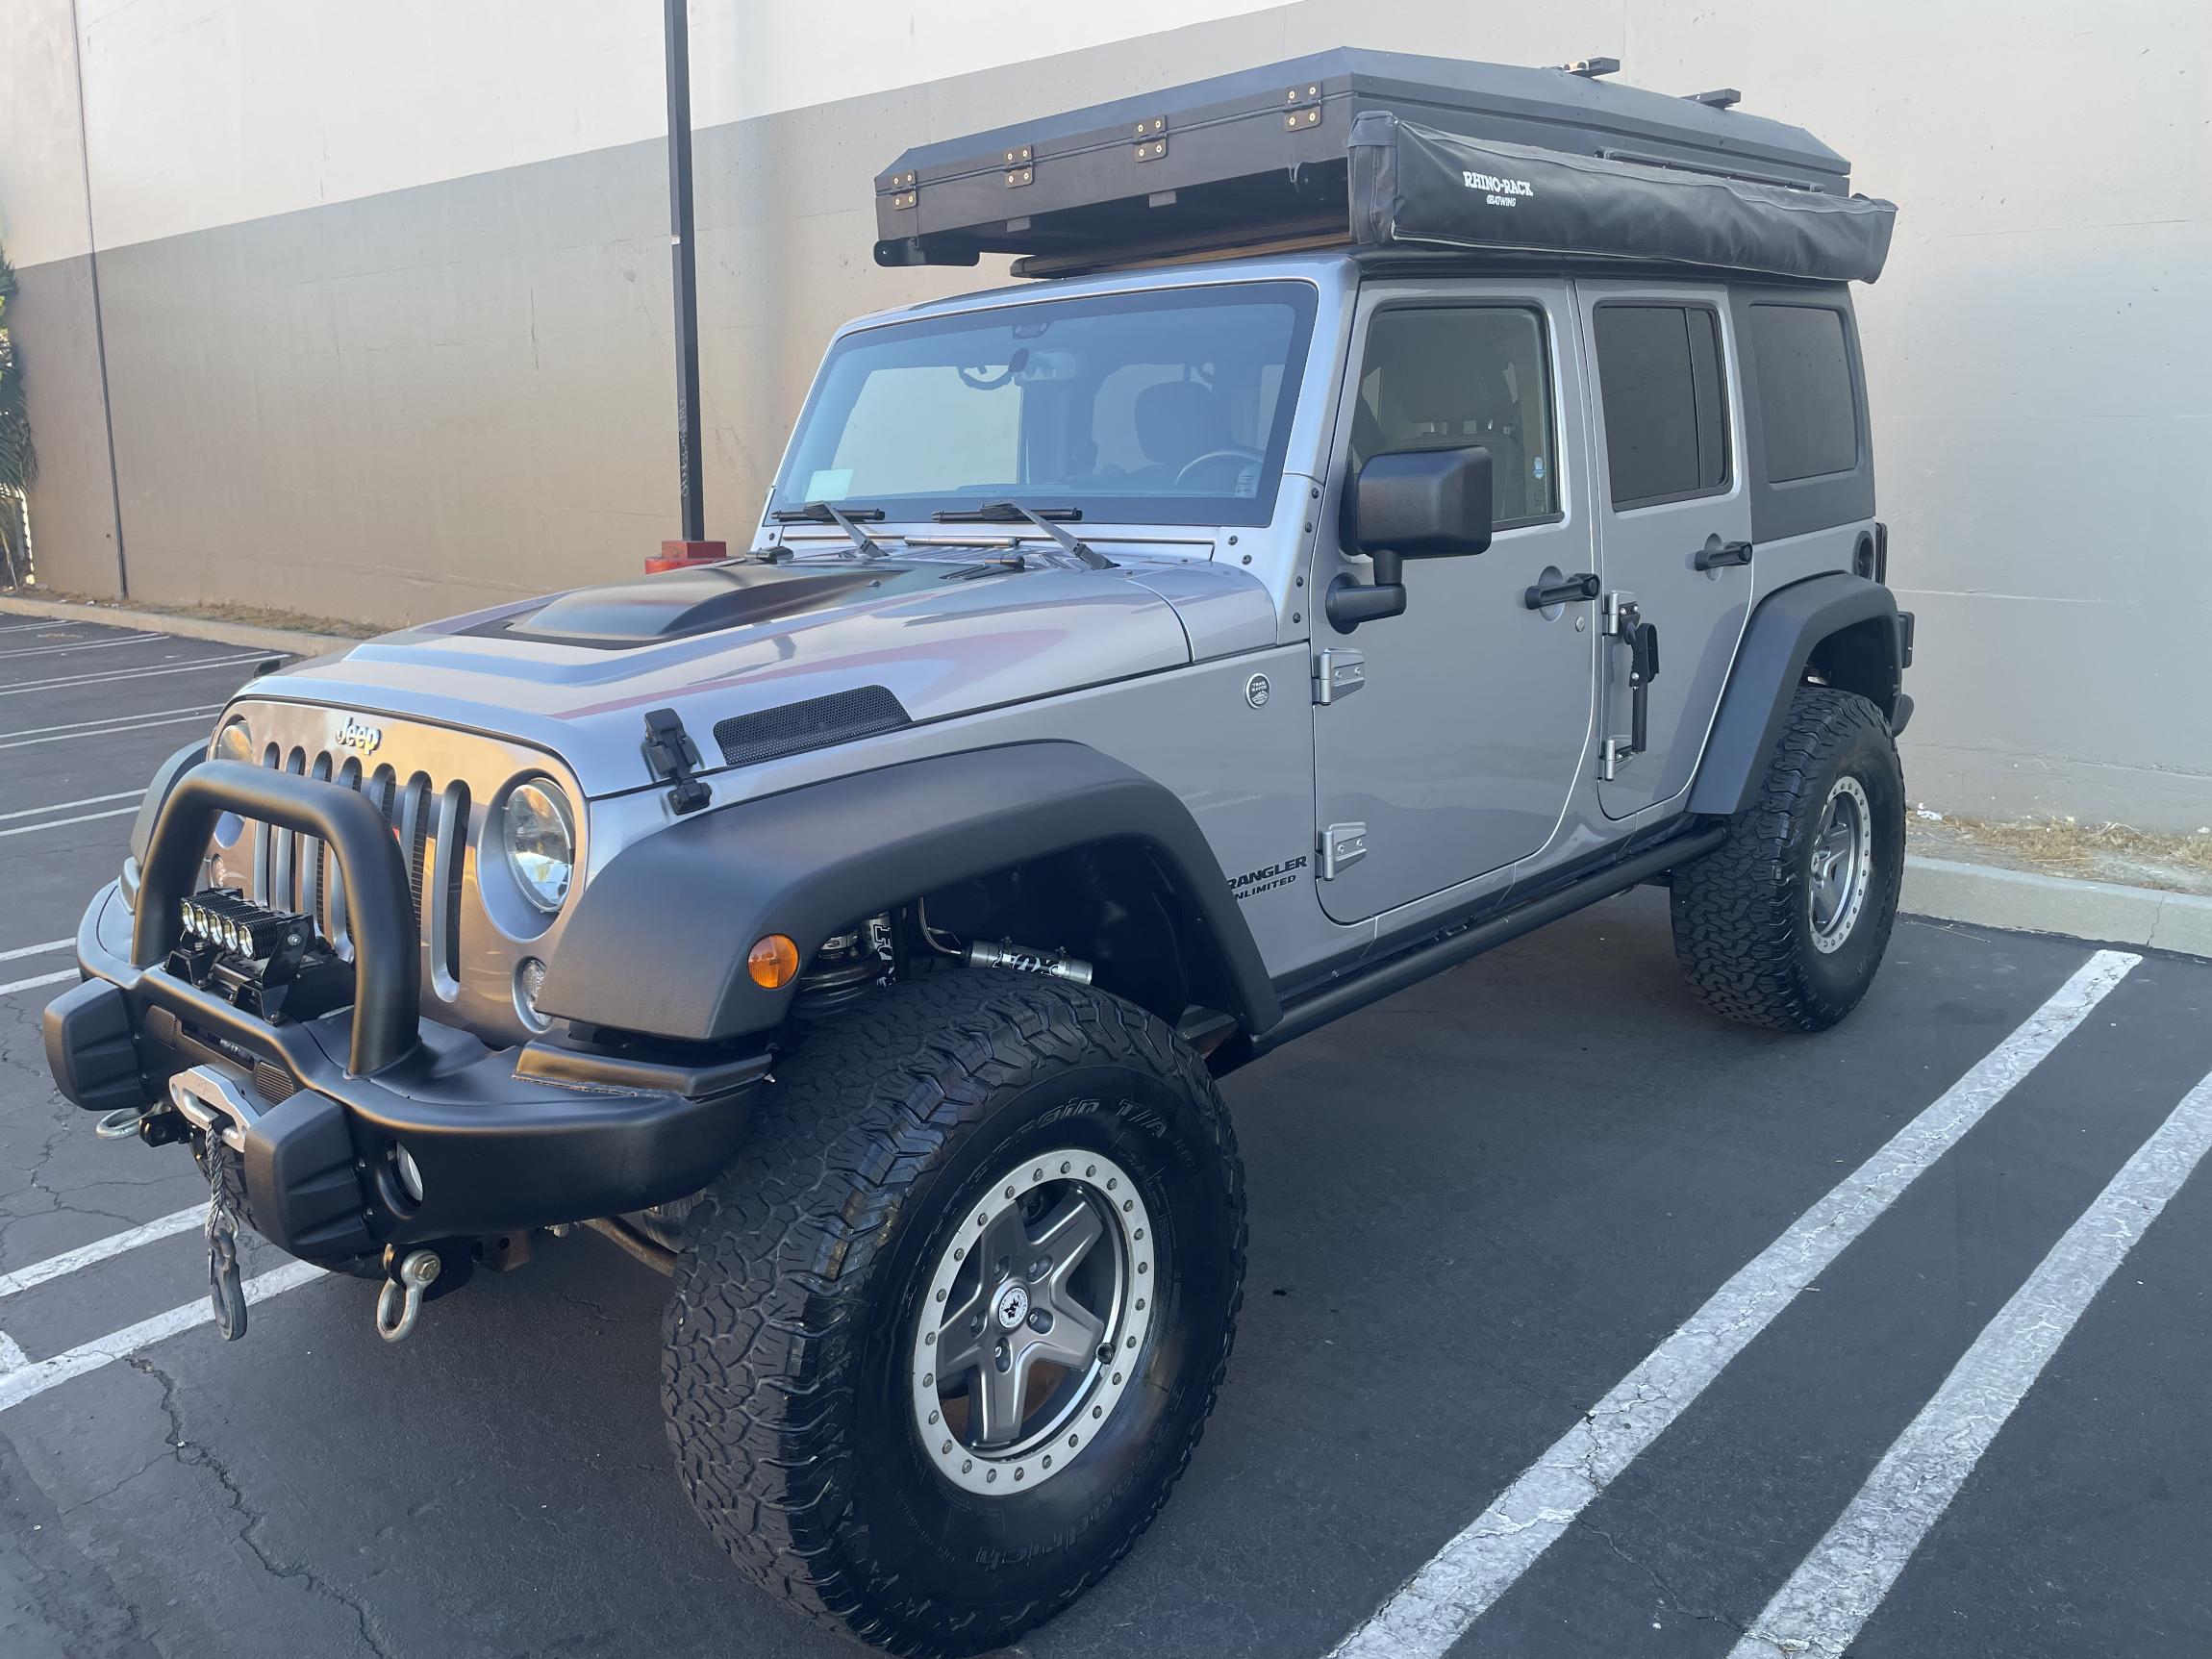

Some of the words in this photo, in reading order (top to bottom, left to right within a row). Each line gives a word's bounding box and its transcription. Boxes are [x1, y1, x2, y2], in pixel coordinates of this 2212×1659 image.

[1463, 171, 1533, 196] RHINO-RACK
[336, 716, 382, 755] Jeep
[1227, 856, 1307, 890] RANGLER
[1232, 874, 1296, 900] NLIMITED
